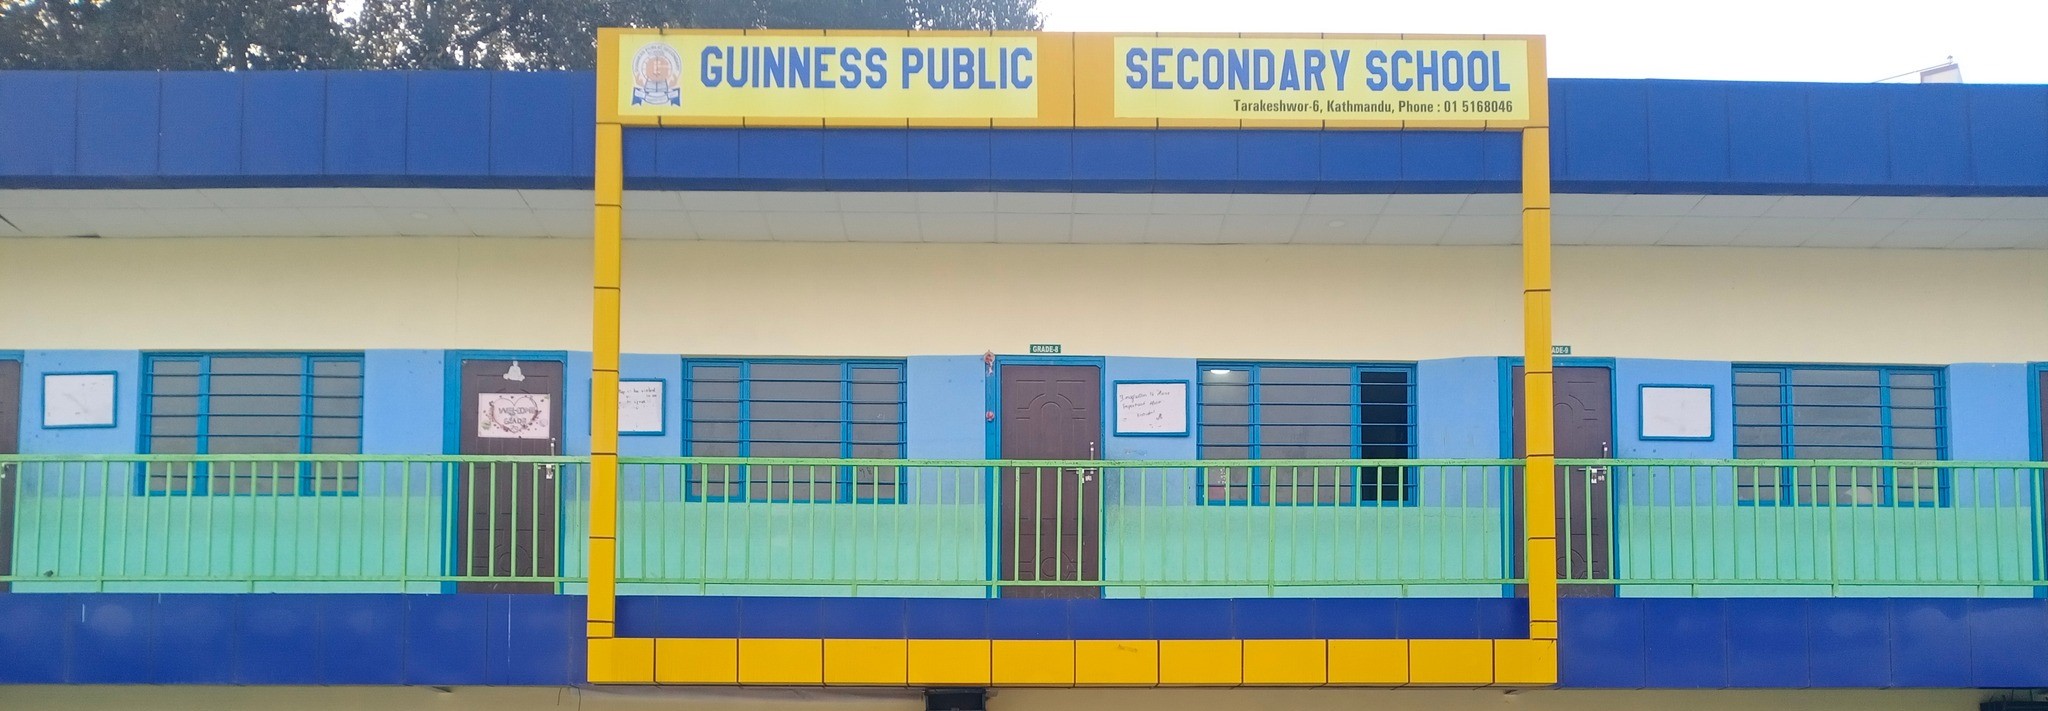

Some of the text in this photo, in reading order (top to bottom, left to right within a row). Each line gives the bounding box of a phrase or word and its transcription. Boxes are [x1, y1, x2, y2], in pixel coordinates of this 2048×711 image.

[701, 46, 887, 89] GUINNESS
[902, 47, 1033, 89] PUBLIC
[1125, 47, 1511, 92] SECONDARY SCHOOL
[1233, 99, 1323, 114] Tarakeshwor-6,
[1327, 100, 1395, 114] Kathmandu,
[1398, 100, 1434, 113] Phone
[1444, 100, 1457, 113] 01
[1462, 100, 1513, 113] 5168046
[1032, 345, 1059, 353] GRADE-8
[1552, 346, 1569, 354] ADE-9
